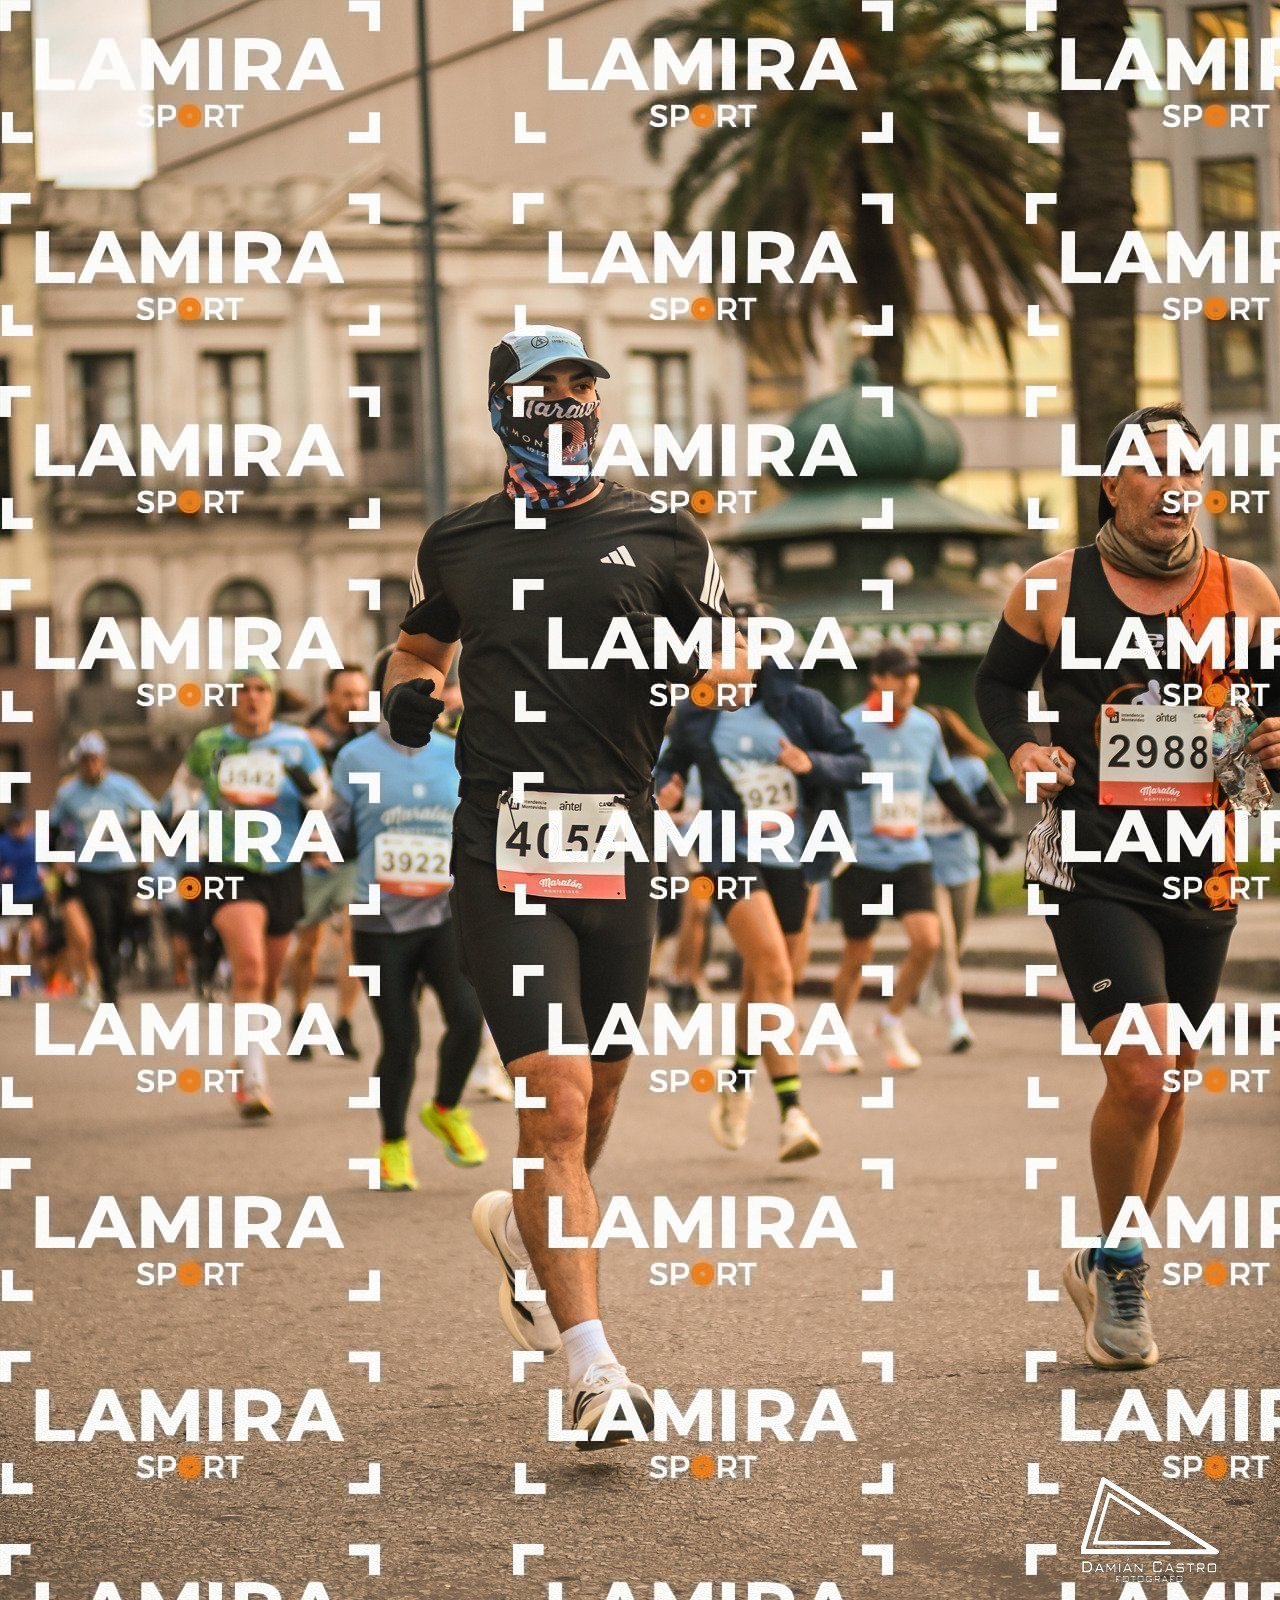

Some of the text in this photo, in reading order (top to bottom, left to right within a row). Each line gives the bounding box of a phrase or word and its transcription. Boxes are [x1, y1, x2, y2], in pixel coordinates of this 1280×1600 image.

[512, 428, 598, 454] MONVIDEO
[1155, 712, 1177, 723] antel
[1107, 734, 1208, 769] 2988
[748, 782, 792, 809] 921
[1139, 785, 1181, 797] Maratón
[559, 800, 582, 811] antel
[381, 851, 447, 874] 3922
[538, 877, 583, 890] Maratón
